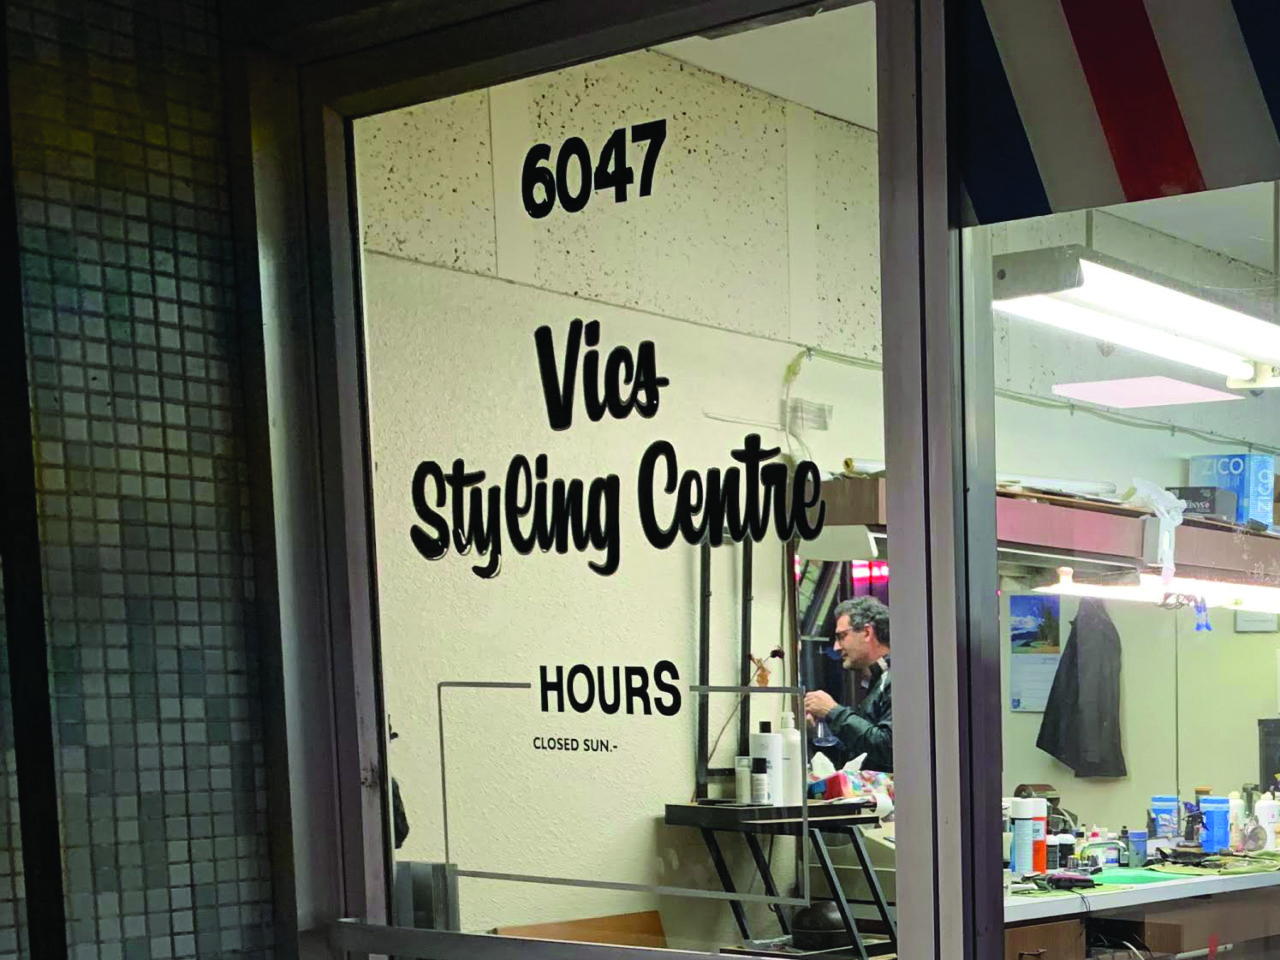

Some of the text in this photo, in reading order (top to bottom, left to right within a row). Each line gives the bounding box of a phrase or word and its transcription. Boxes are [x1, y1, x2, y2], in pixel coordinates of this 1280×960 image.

[521, 119, 667, 219] 6047
[534, 318, 670, 431] Vics
[1202, 458, 1244, 474] ZICO
[1257, 469, 1273, 512] ZICO
[409, 433, 826, 579] Styling Centre
[539, 660, 682, 717] HOURS
[533, 736, 579, 751] CLOSED
